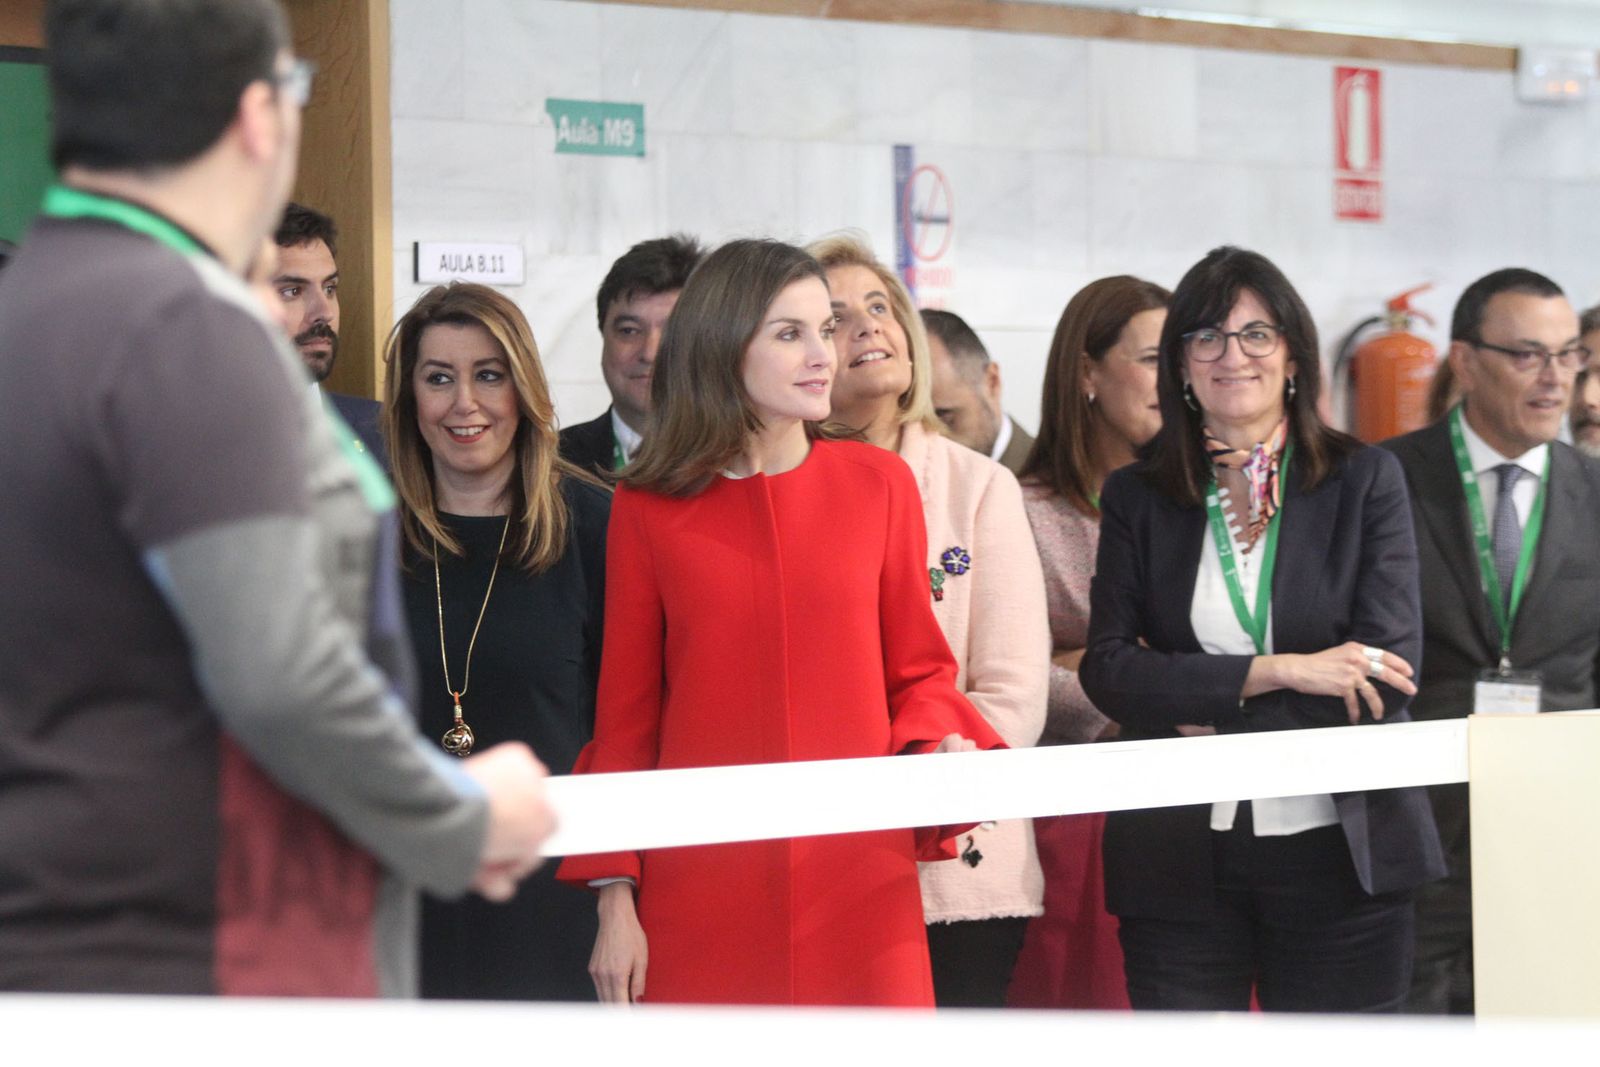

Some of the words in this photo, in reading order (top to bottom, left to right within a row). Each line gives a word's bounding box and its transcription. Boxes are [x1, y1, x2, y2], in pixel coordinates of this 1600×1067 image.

[557, 114, 600, 144] Aula
[603, 118, 635, 147] M9
[439, 254, 474, 273] AULA
[477, 255, 504, 273] B.11
